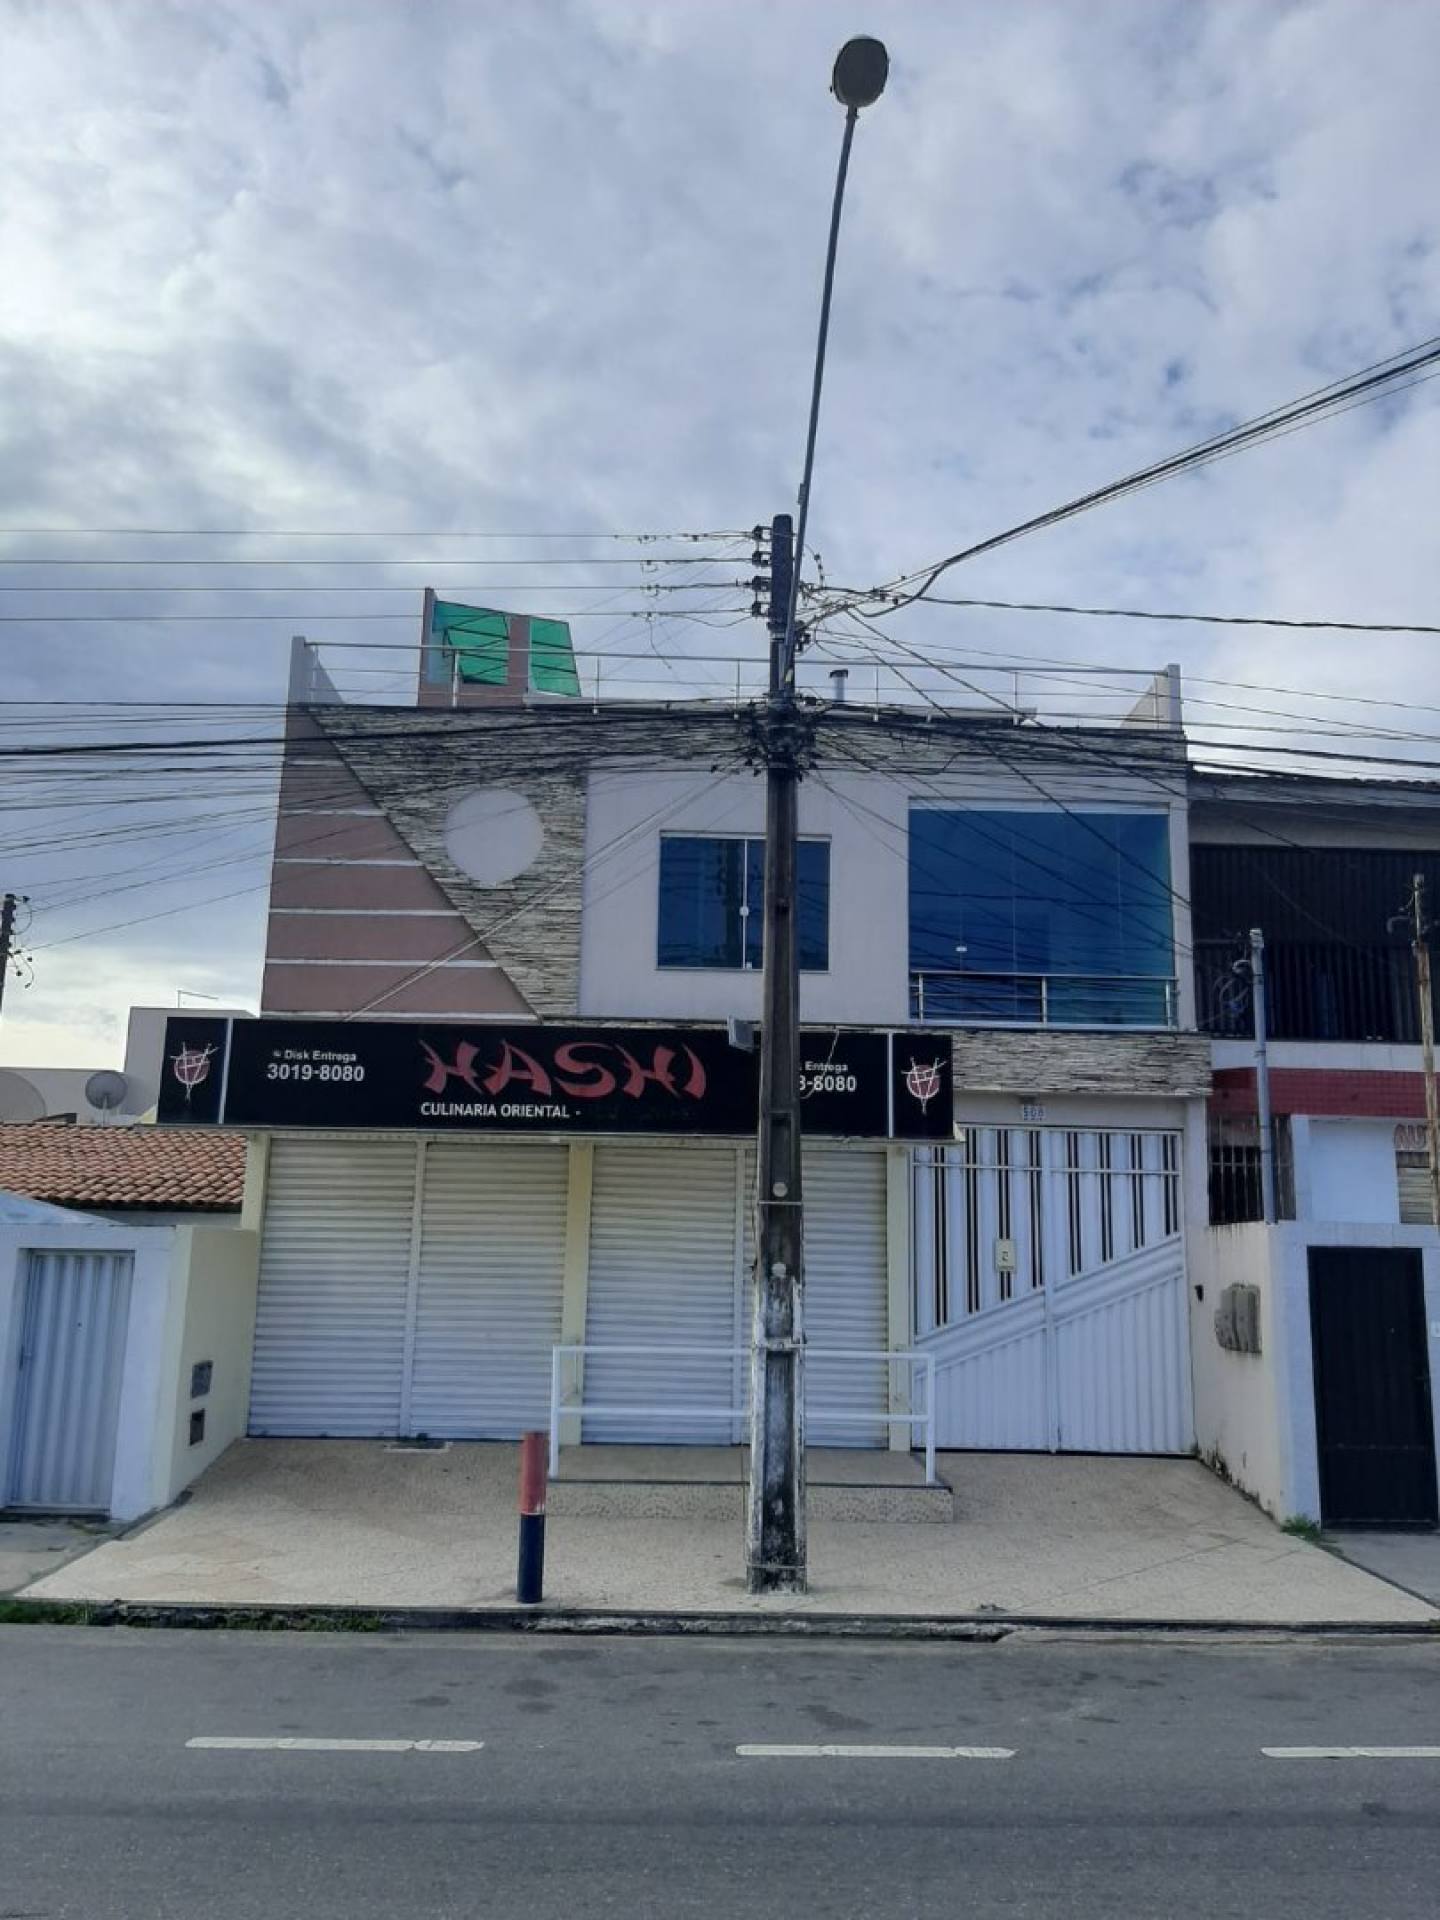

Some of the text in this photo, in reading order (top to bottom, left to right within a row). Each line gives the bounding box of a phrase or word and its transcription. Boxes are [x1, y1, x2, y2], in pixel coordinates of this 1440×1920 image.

[284, 1049, 357, 1064] Disk Entrega
[267, 1063, 365, 1082] 3019-8080
[419, 1039, 708, 1099] HASHI
[799, 1074, 858, 1093] 3-8080
[420, 1101, 570, 1119] CULINARIA ORIENTAL
